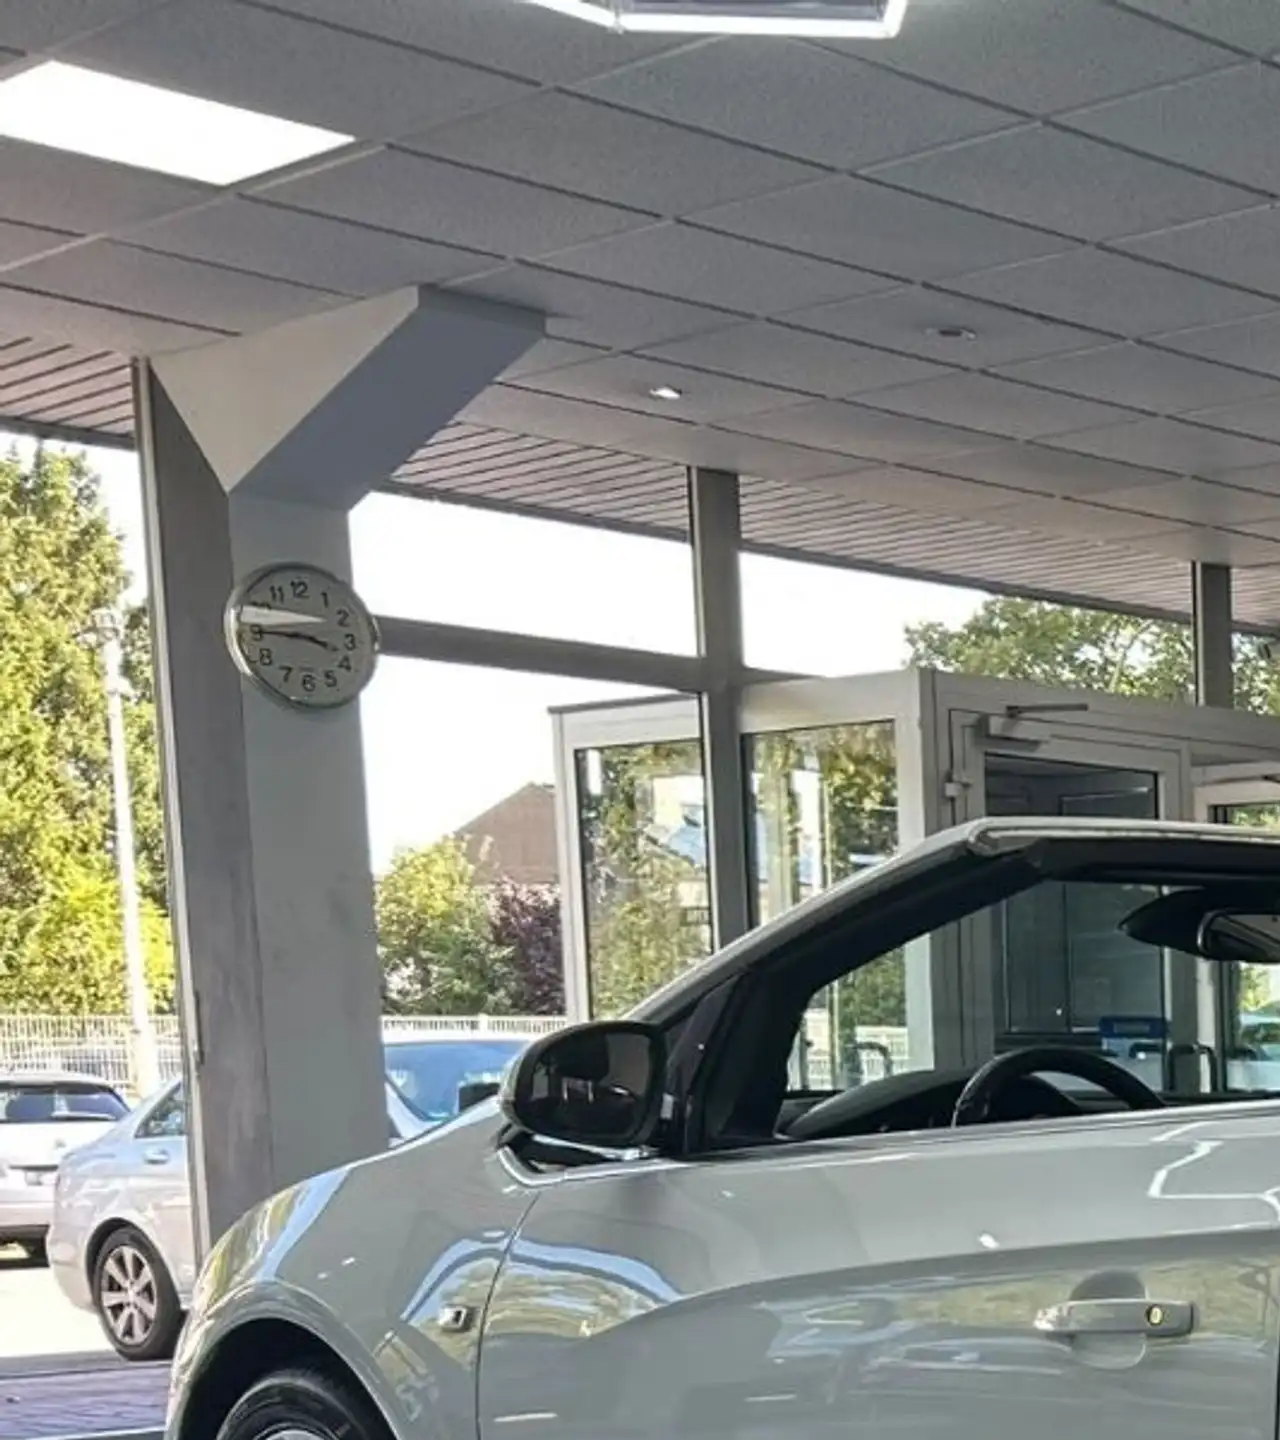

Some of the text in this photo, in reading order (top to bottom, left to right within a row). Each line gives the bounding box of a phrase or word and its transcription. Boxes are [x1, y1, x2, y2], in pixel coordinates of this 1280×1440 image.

[269, 586, 285, 603] 11
[290, 580, 310, 599] 12
[320, 591, 329, 608] 1
[336, 609, 349, 627] 2
[250, 624, 263, 641] 9
[344, 633, 356, 651] 3
[259, 648, 272, 666] 8
[337, 656, 352, 671] 4
[280, 666, 292, 683] 7
[302, 674, 315, 692] 6
[324, 670, 337, 687] 5
